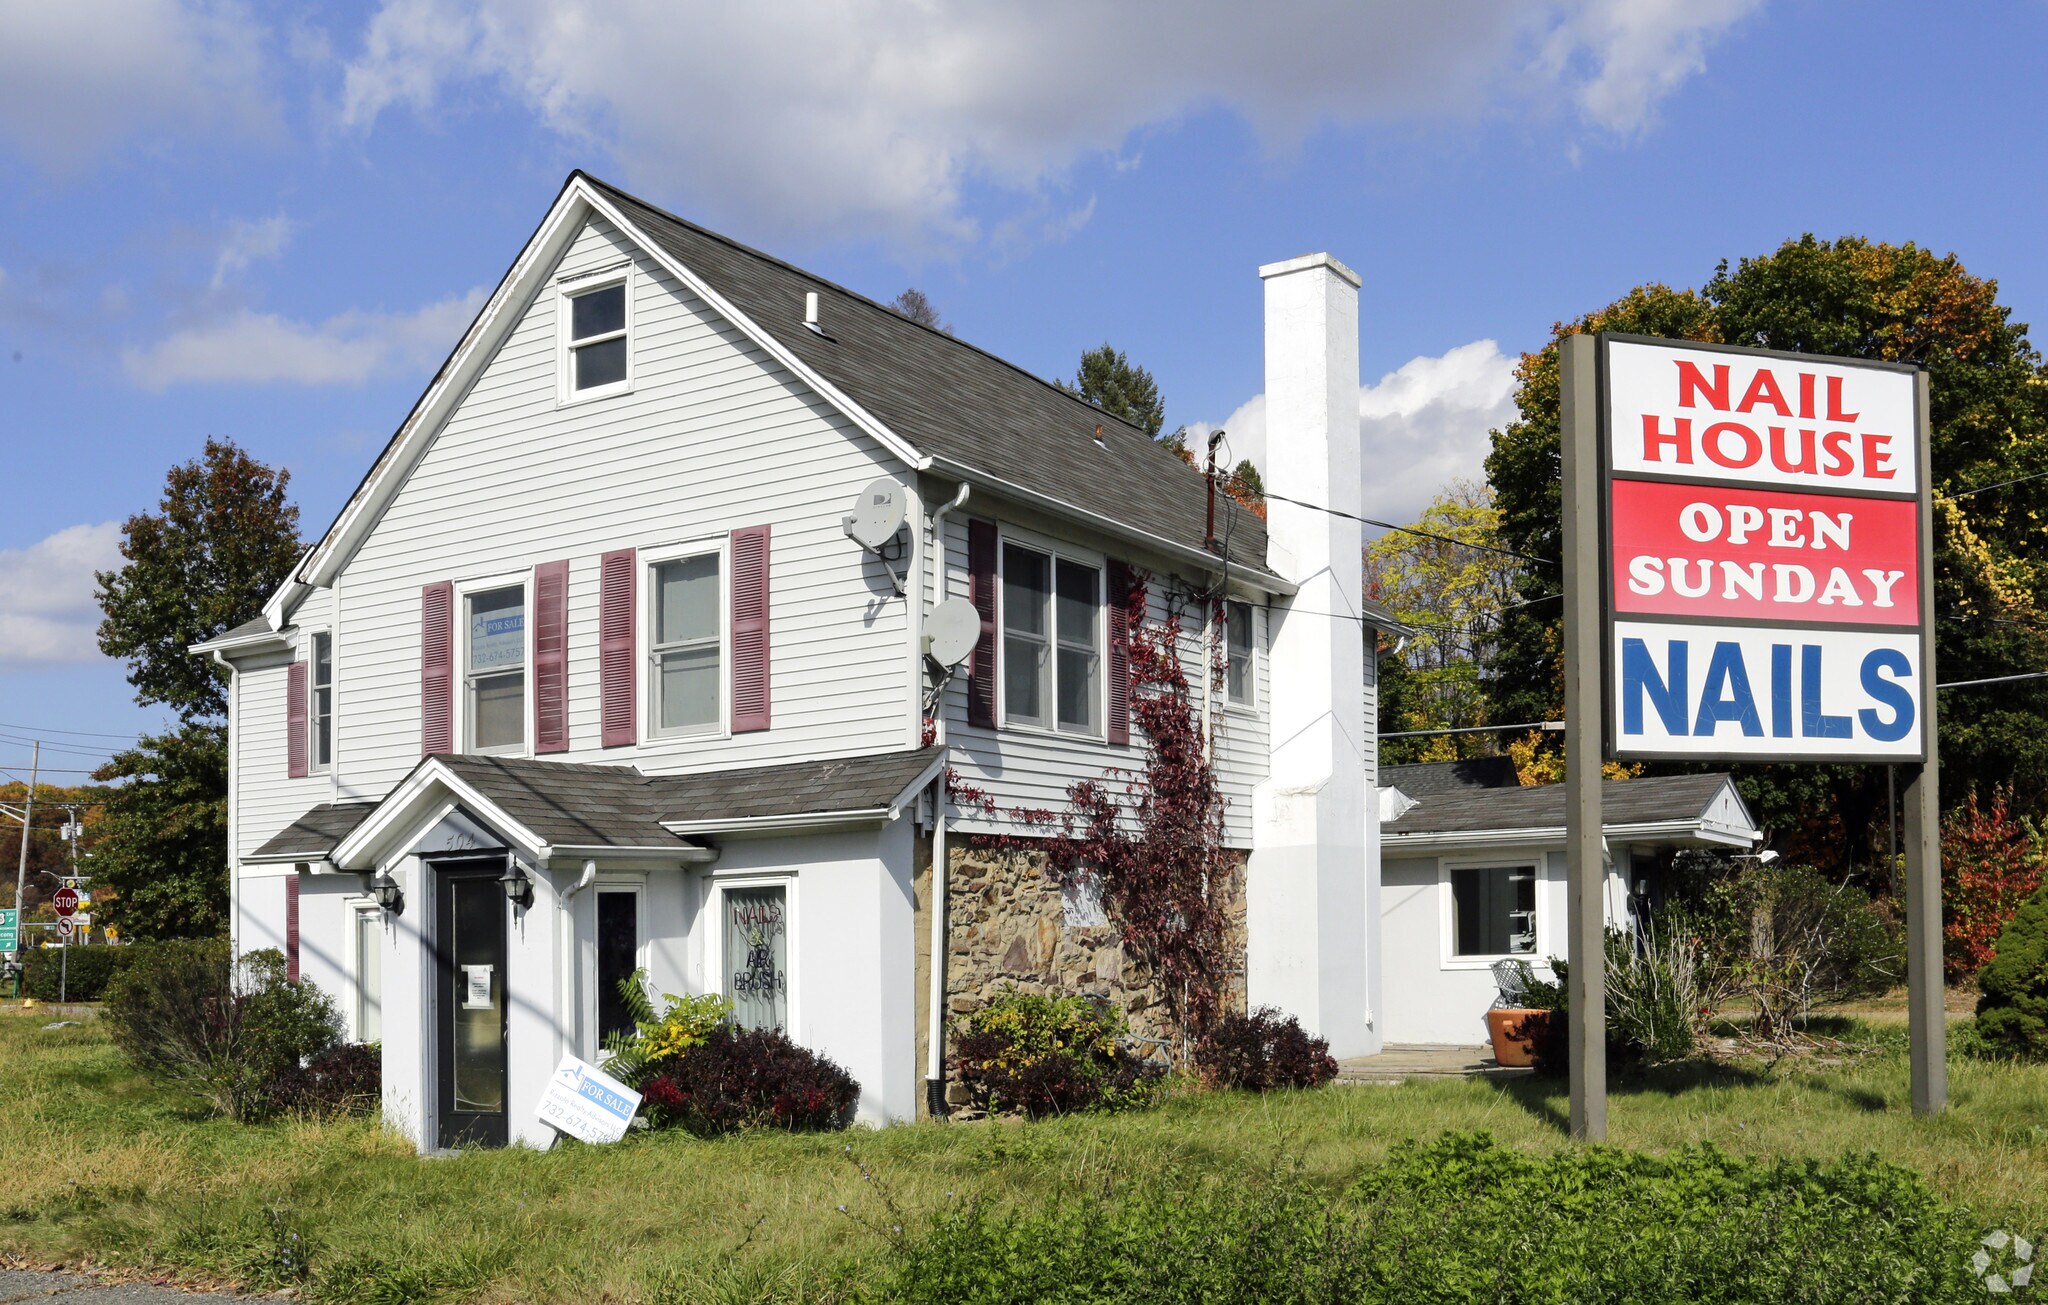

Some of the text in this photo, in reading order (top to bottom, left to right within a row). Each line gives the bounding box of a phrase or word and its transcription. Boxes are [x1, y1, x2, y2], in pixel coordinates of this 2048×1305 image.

[1672, 359, 1860, 423] NAIL
[1641, 414, 1898, 479] HOUSE
[1679, 502, 1854, 551] OPEN
[1628, 555, 1905, 608] SUNDAY
[487, 617, 525, 633] FOR SALE
[1622, 637, 1915, 742] NAILS
[55, 897, 78, 908] STOP
[734, 904, 781, 925] NAILS
[734, 970, 783, 991] BRUSH
[581, 1080, 633, 1117] FOR SALE
